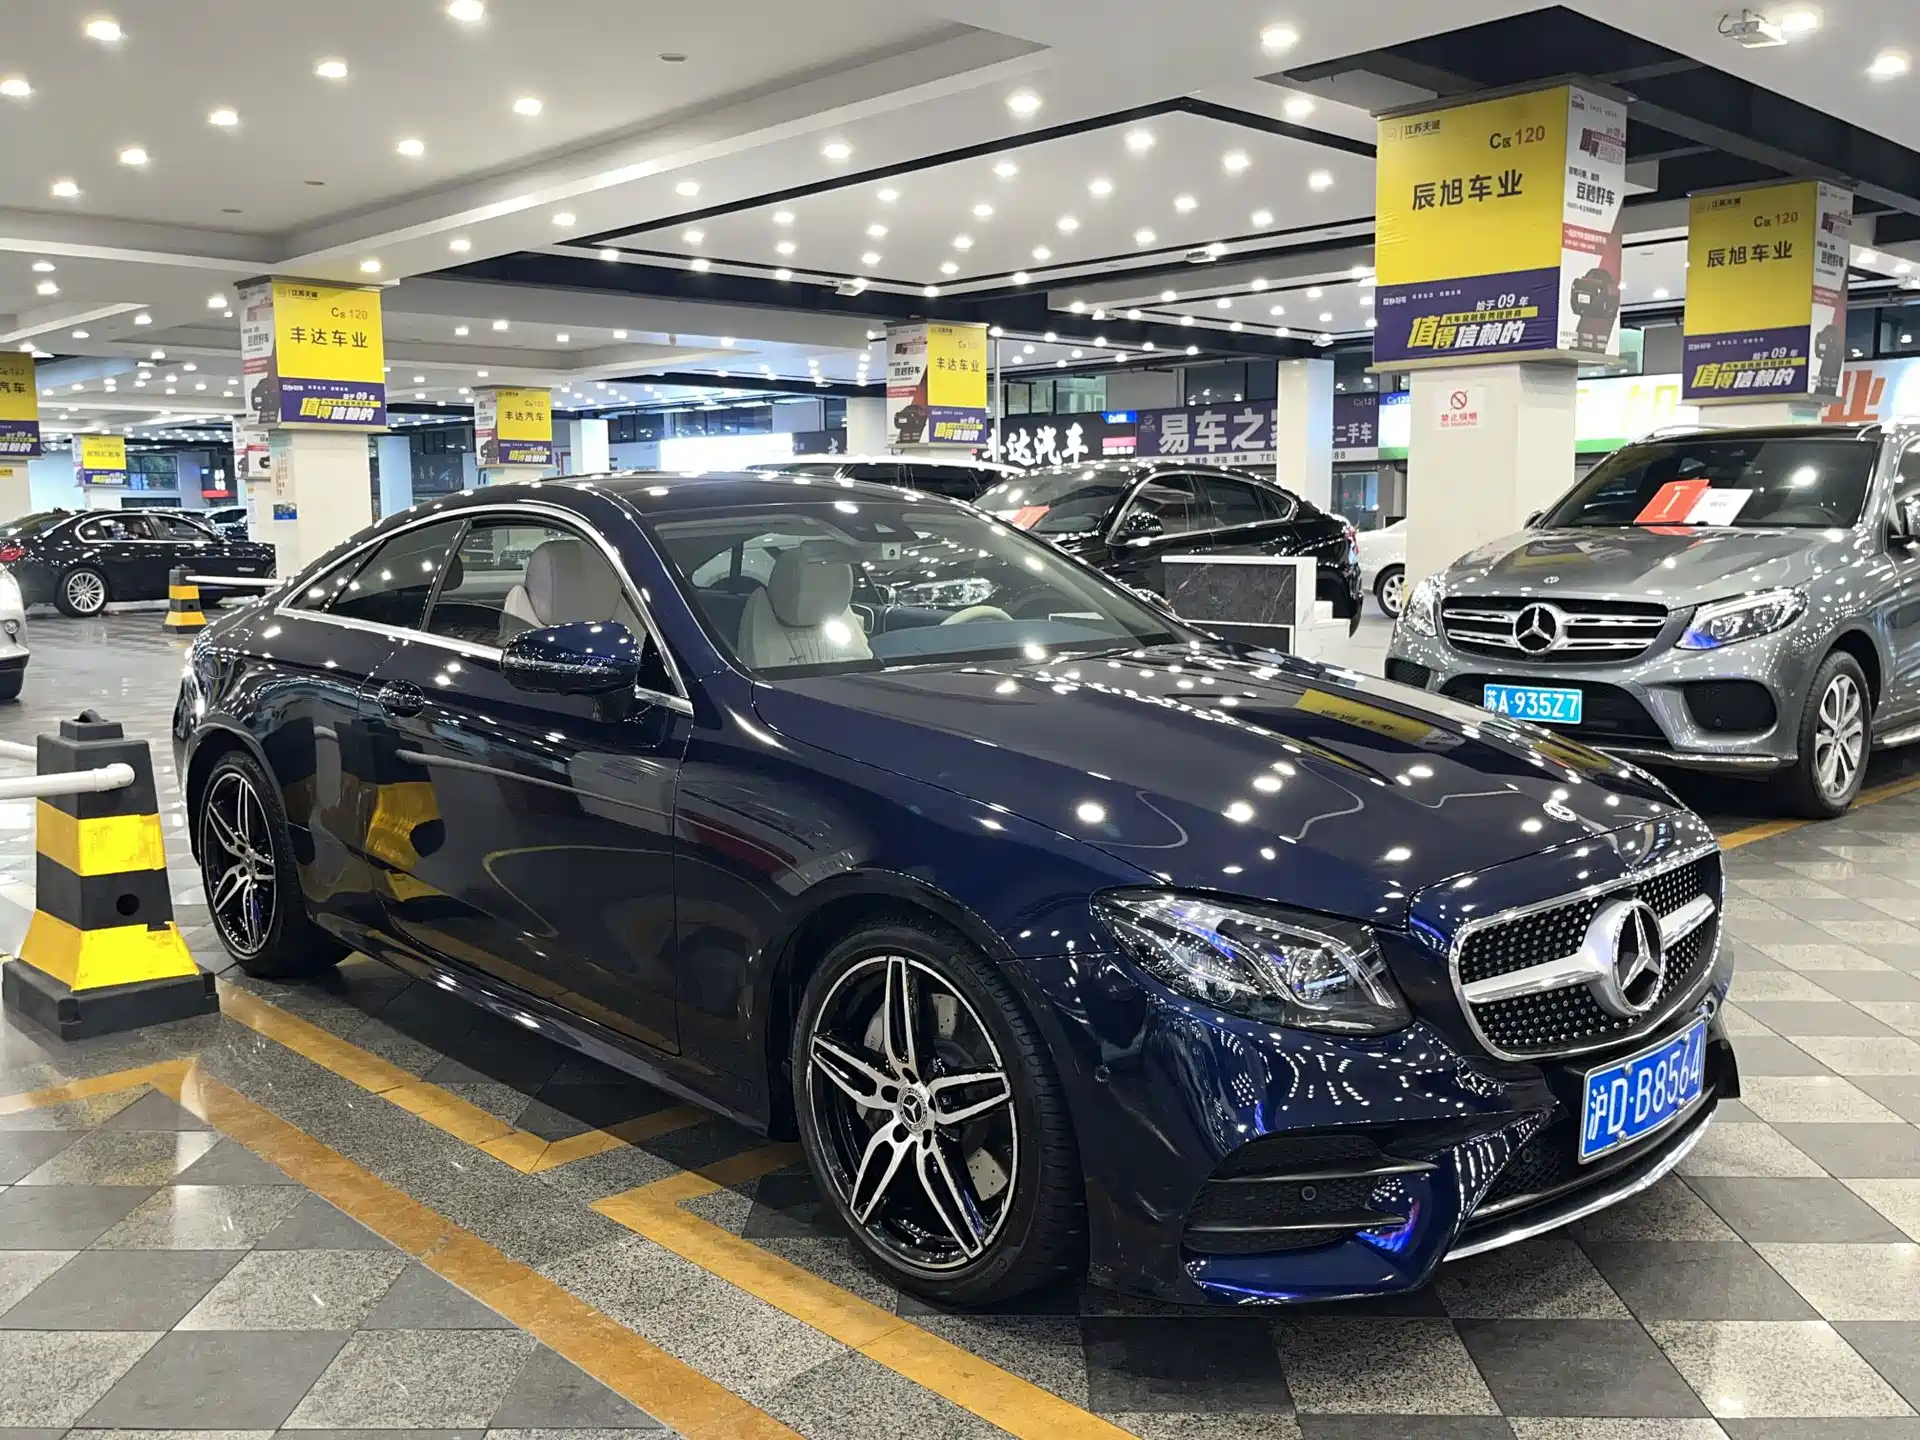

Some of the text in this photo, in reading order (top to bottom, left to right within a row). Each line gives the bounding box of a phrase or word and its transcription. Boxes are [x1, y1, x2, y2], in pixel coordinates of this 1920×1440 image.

[1515, 125, 1546, 146] 120
[1412, 168, 1523, 211] 辰旭车业
[1775, 211, 1799, 226] 120
[1707, 240, 1793, 268] 辰旭车业
[1498, 293, 1515, 308] 09
[1519, 296, 1529, 307] 年
[349, 309, 368, 320] 120
[290, 326, 369, 348] 丰达车业
[1407, 315, 1526, 350] 值得信赖的
[1771, 346, 1787, 359] 09
[936, 357, 980, 372] 丰达车业
[504, 411, 544, 422] 丰达汽车
